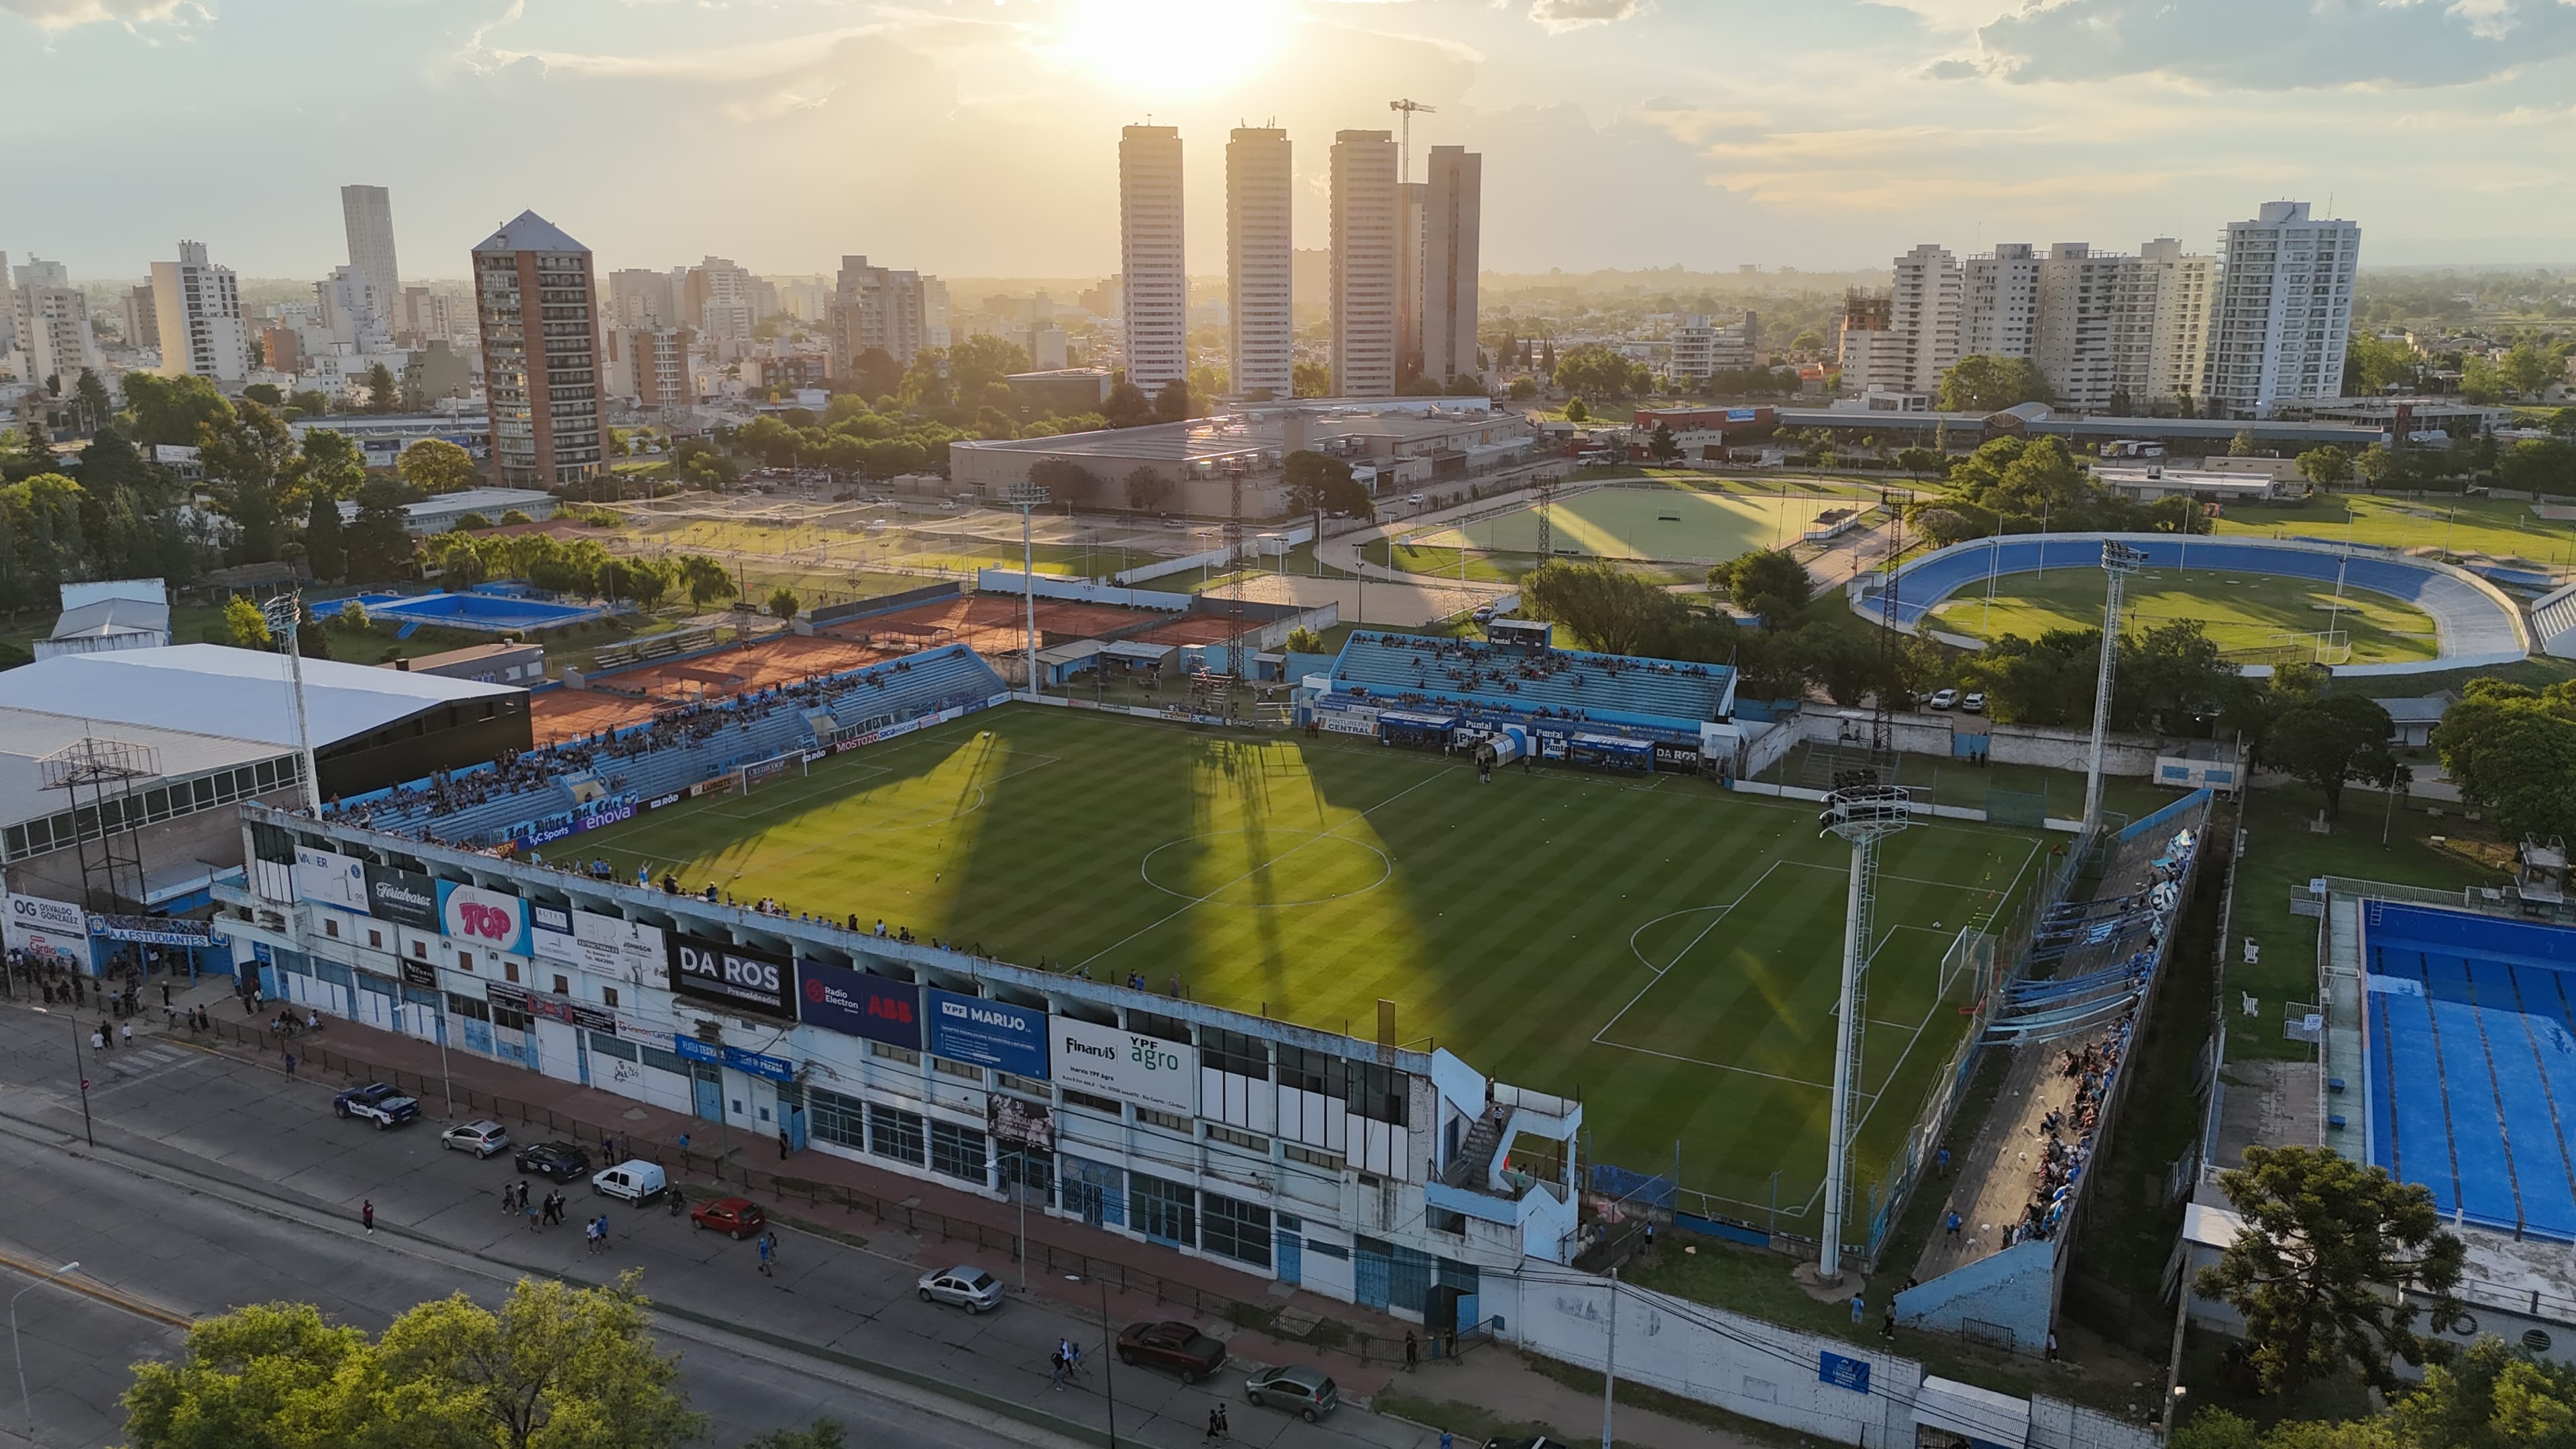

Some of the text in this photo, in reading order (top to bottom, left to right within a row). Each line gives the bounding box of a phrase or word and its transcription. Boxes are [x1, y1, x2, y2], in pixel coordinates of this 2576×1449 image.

[1491, 637, 1511, 645] Puntal
[1328, 718, 1370, 728] PINTURERIA
[1328, 723, 1371, 735] CENTRAL
[1465, 720, 1492, 731] Puntal
[1536, 728, 1564, 739] Puntal
[1656, 748, 1697, 761] DA ROS
[748, 760, 786, 776] CREDICOOP
[586, 806, 631, 830] enova
[528, 826, 570, 846] TyC Sports
[14, 900, 37, 916] OG
[39, 904, 72, 916] OSVALDO
[40, 912, 79, 925] GONZALEZ
[459, 902, 511, 941] TOP
[623, 942, 652, 953] JOHNSON
[680, 946, 780, 991] DA ROS
[727, 986, 782, 1007] Premoldeados
[824, 986, 848, 999] Radio
[825, 994, 859, 1010] Electron
[867, 994, 913, 1024] ABB
[945, 1004, 965, 1015] YPF
[971, 1008, 1026, 1031] MARIJO
[627, 1024, 652, 1036] Grandes
[682, 1040, 699, 1053] PLATEA
[1130, 1036, 1159, 1050] YPF
[1131, 1046, 1179, 1071] agro
[1101, 1073, 1114, 1081] Agro
[1015, 1101, 1024, 1110] 30
